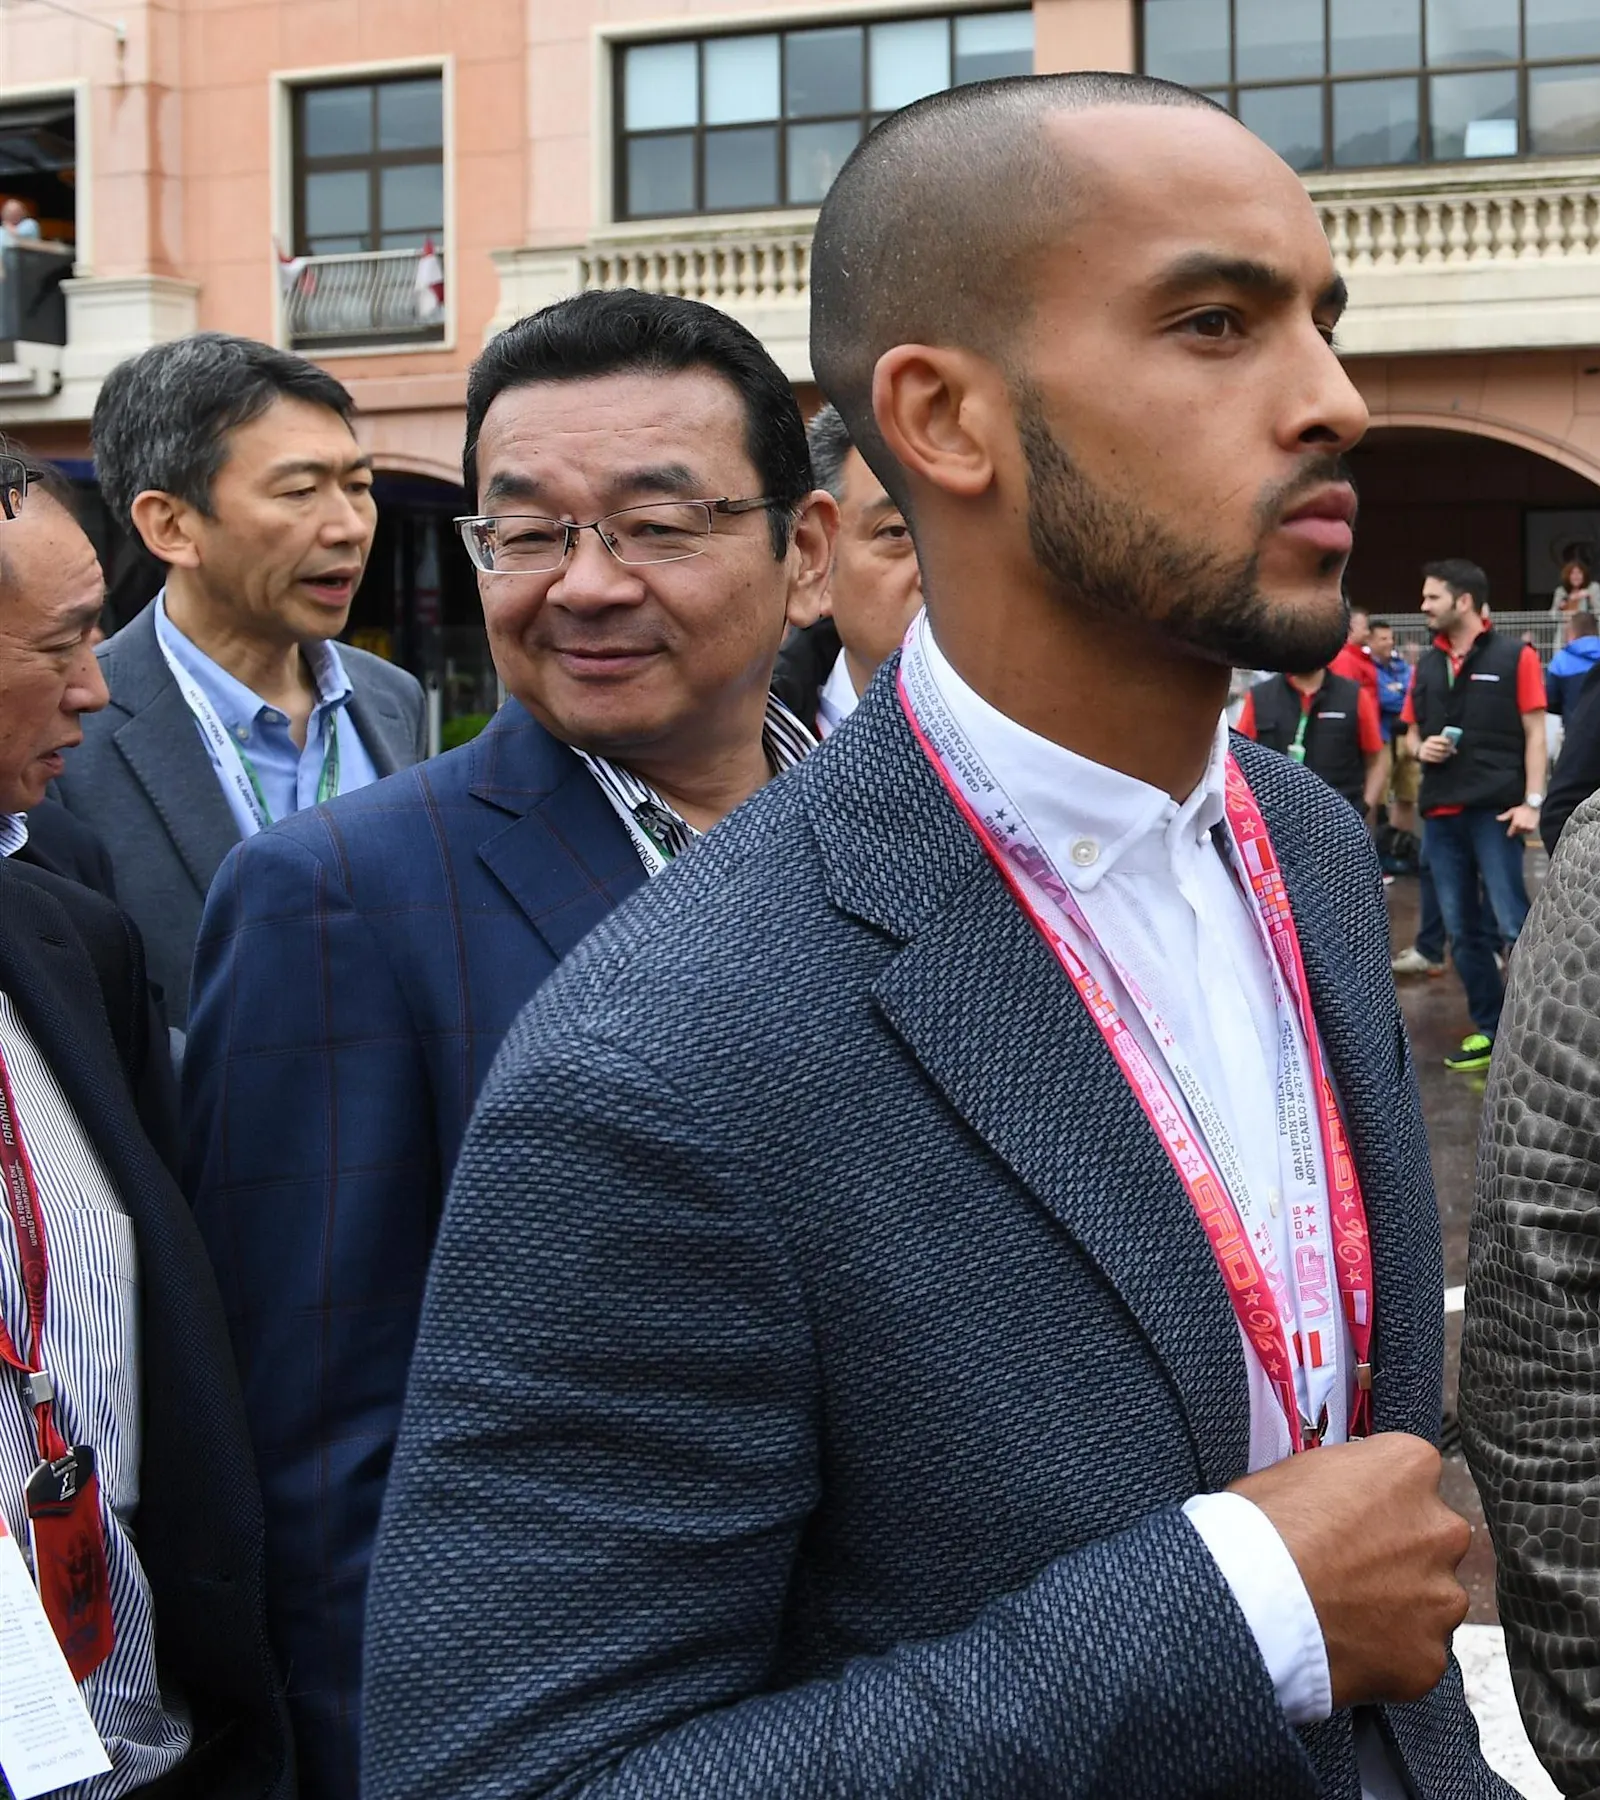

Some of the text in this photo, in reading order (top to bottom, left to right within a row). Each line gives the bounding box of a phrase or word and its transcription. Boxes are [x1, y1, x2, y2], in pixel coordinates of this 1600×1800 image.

[910, 679, 934, 721] MONACO
[930, 721, 943, 735] DE
[941, 717, 969, 754] CARLO
[938, 735, 959, 761] PRIX
[955, 761, 981, 793] GRAN
[963, 752, 995, 793] MONTE
[983, 815, 1009, 845] 2016
[632, 838, 660, 875] HONDA
[1007, 841, 1066, 906] VIP
[1283, 1052, 1295, 1101] MONACO
[1277, 1081, 1287, 1136] FORMULA
[1288, 1103, 1295, 1118] DE
[1298, 1106, 1310, 1144] CARLO
[1173, 1064, 1199, 1104] MONTE
[1193, 1102, 1215, 1137] CARLO
[1235, 1193, 1252, 1220] MAY
[1289, 1120, 1299, 1145] PRIX
[1198, 1096, 1214, 1122] PRIX
[1211, 1120, 1222, 1136] DE
[1217, 1135, 1244, 1184] MONACO
[1240, 1183, 1254, 1207] 2016
[1293, 1147, 1304, 1181] GRAN
[1303, 1143, 1316, 1186] MONTE
[9, 1164, 20, 1179] ONE
[12, 1179, 25, 1215] FORMULA
[25, 1220, 38, 1246] WORLD
[1187, 1172, 1261, 1294] GRID
[1292, 1205, 1303, 1240] 2016
[1295, 1244, 1330, 1320] VIP
